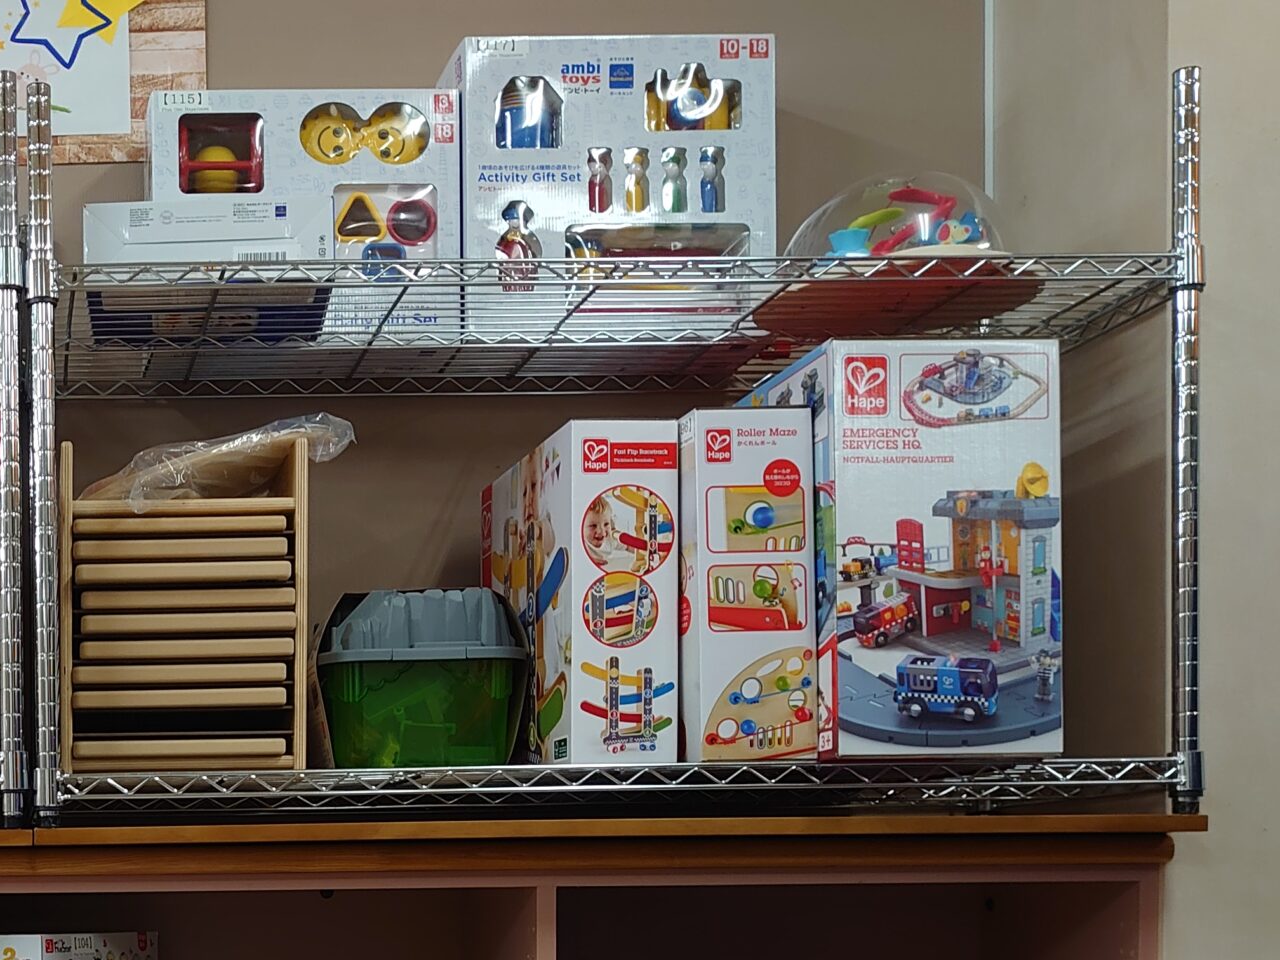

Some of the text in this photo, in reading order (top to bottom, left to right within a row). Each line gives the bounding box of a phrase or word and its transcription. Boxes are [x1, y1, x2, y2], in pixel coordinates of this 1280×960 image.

[721, 40, 766, 54] 10 18
[561, 62, 600, 74] ambi
[561, 75, 601, 86] toys
[164, 93, 202, 105] 【115】
[437, 125, 452, 137] 18
[478, 172, 582, 183] Activity Gift Set
[847, 395, 885, 409] Hape
[737, 427, 797, 437] Roller Maze
[843, 428, 918, 438] EMERGENCY
[843, 440, 898, 449] SERVICES
[708, 450, 730, 460] Hape
[843, 456, 954, 464] NOTFALL-HAUPTQUARTIER
[584, 460, 607, 470] Hape
